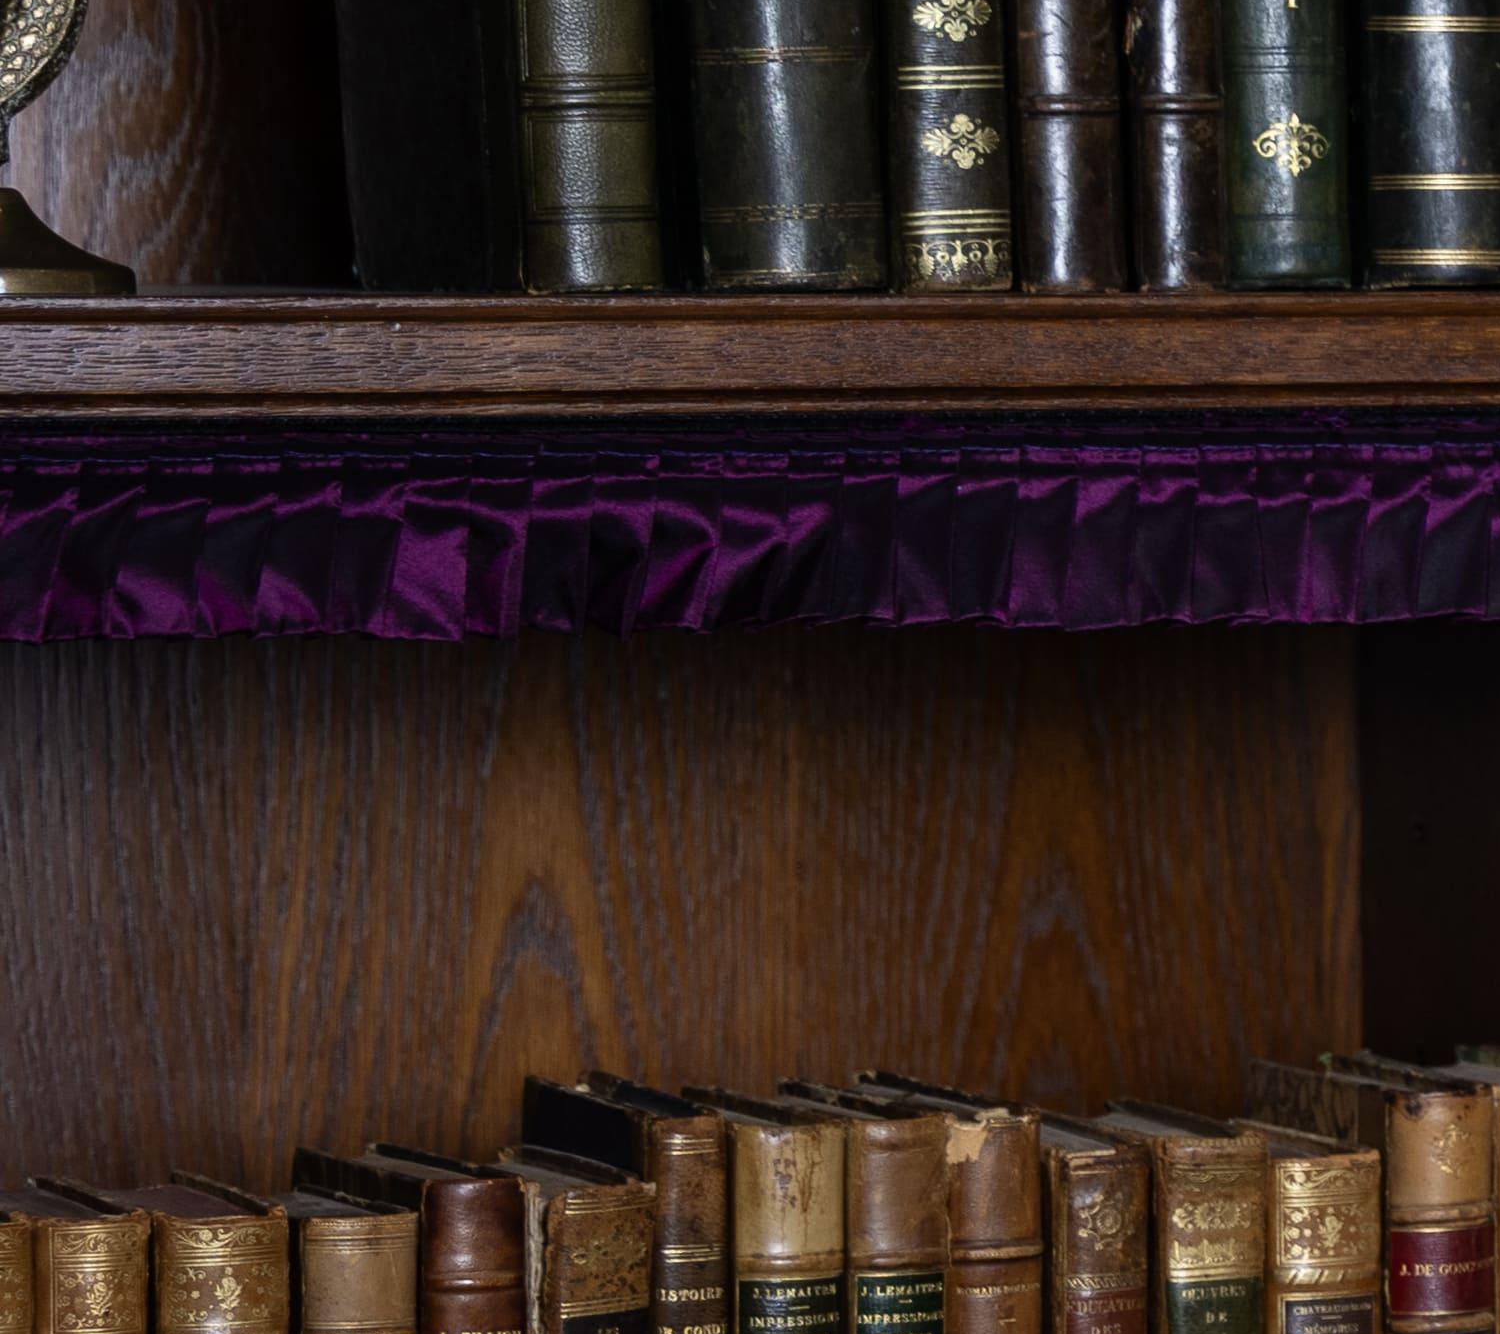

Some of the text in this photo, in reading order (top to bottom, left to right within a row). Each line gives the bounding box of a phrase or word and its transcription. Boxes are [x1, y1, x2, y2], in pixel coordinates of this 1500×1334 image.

[1399, 1263, 1411, 1276] J.
[1415, 1263, 1434, 1277] DE
[655, 1286, 726, 1303] ISTOIRE
[752, 1287, 763, 1300] J.
[861, 1285, 873, 1297] J.
[1205, 1312, 1229, 1324] DE
